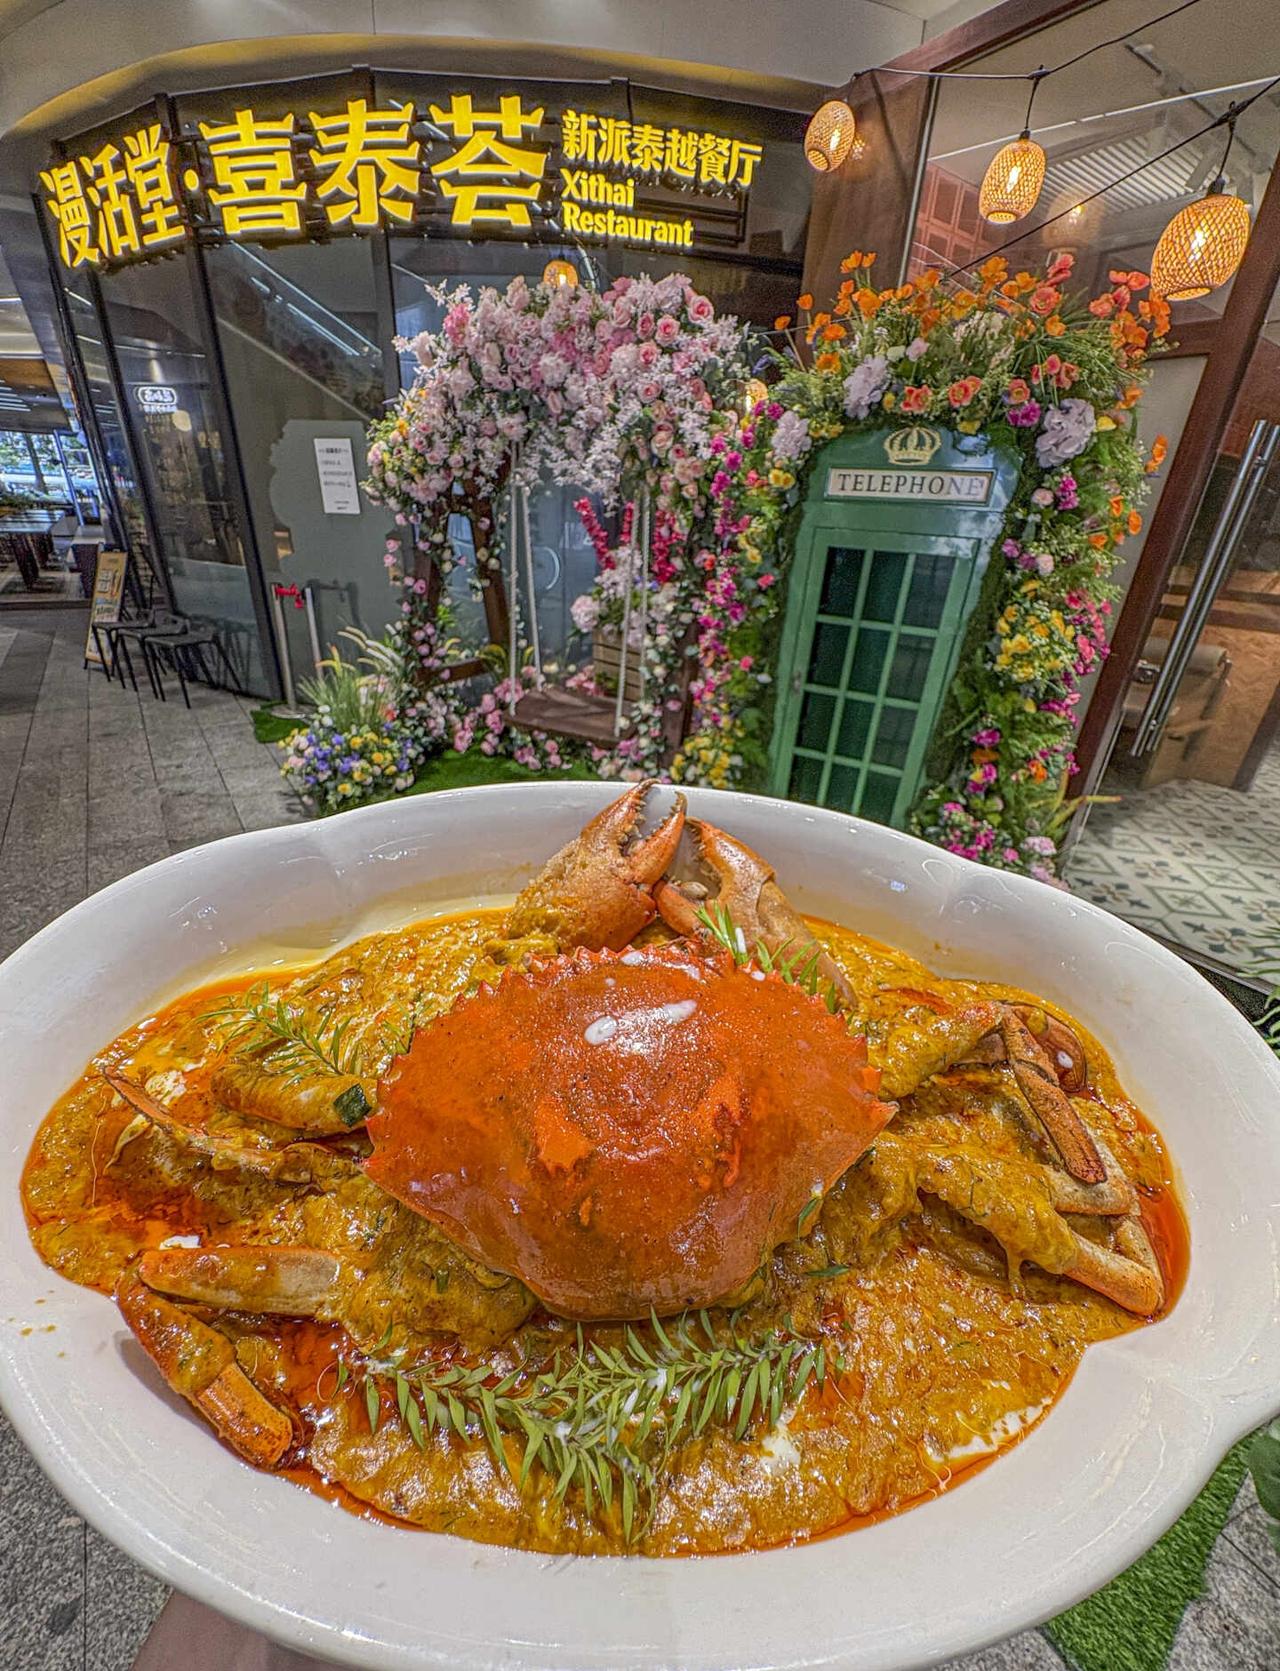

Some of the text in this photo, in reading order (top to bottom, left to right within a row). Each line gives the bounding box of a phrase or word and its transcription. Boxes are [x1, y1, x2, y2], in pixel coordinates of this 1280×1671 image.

[561, 110, 763, 187] 新派泰越餐厅
[561, 168, 635, 207] Xithai
[562, 202, 694, 246] Restaurant
[838, 474, 984, 496] TELEPHONE
